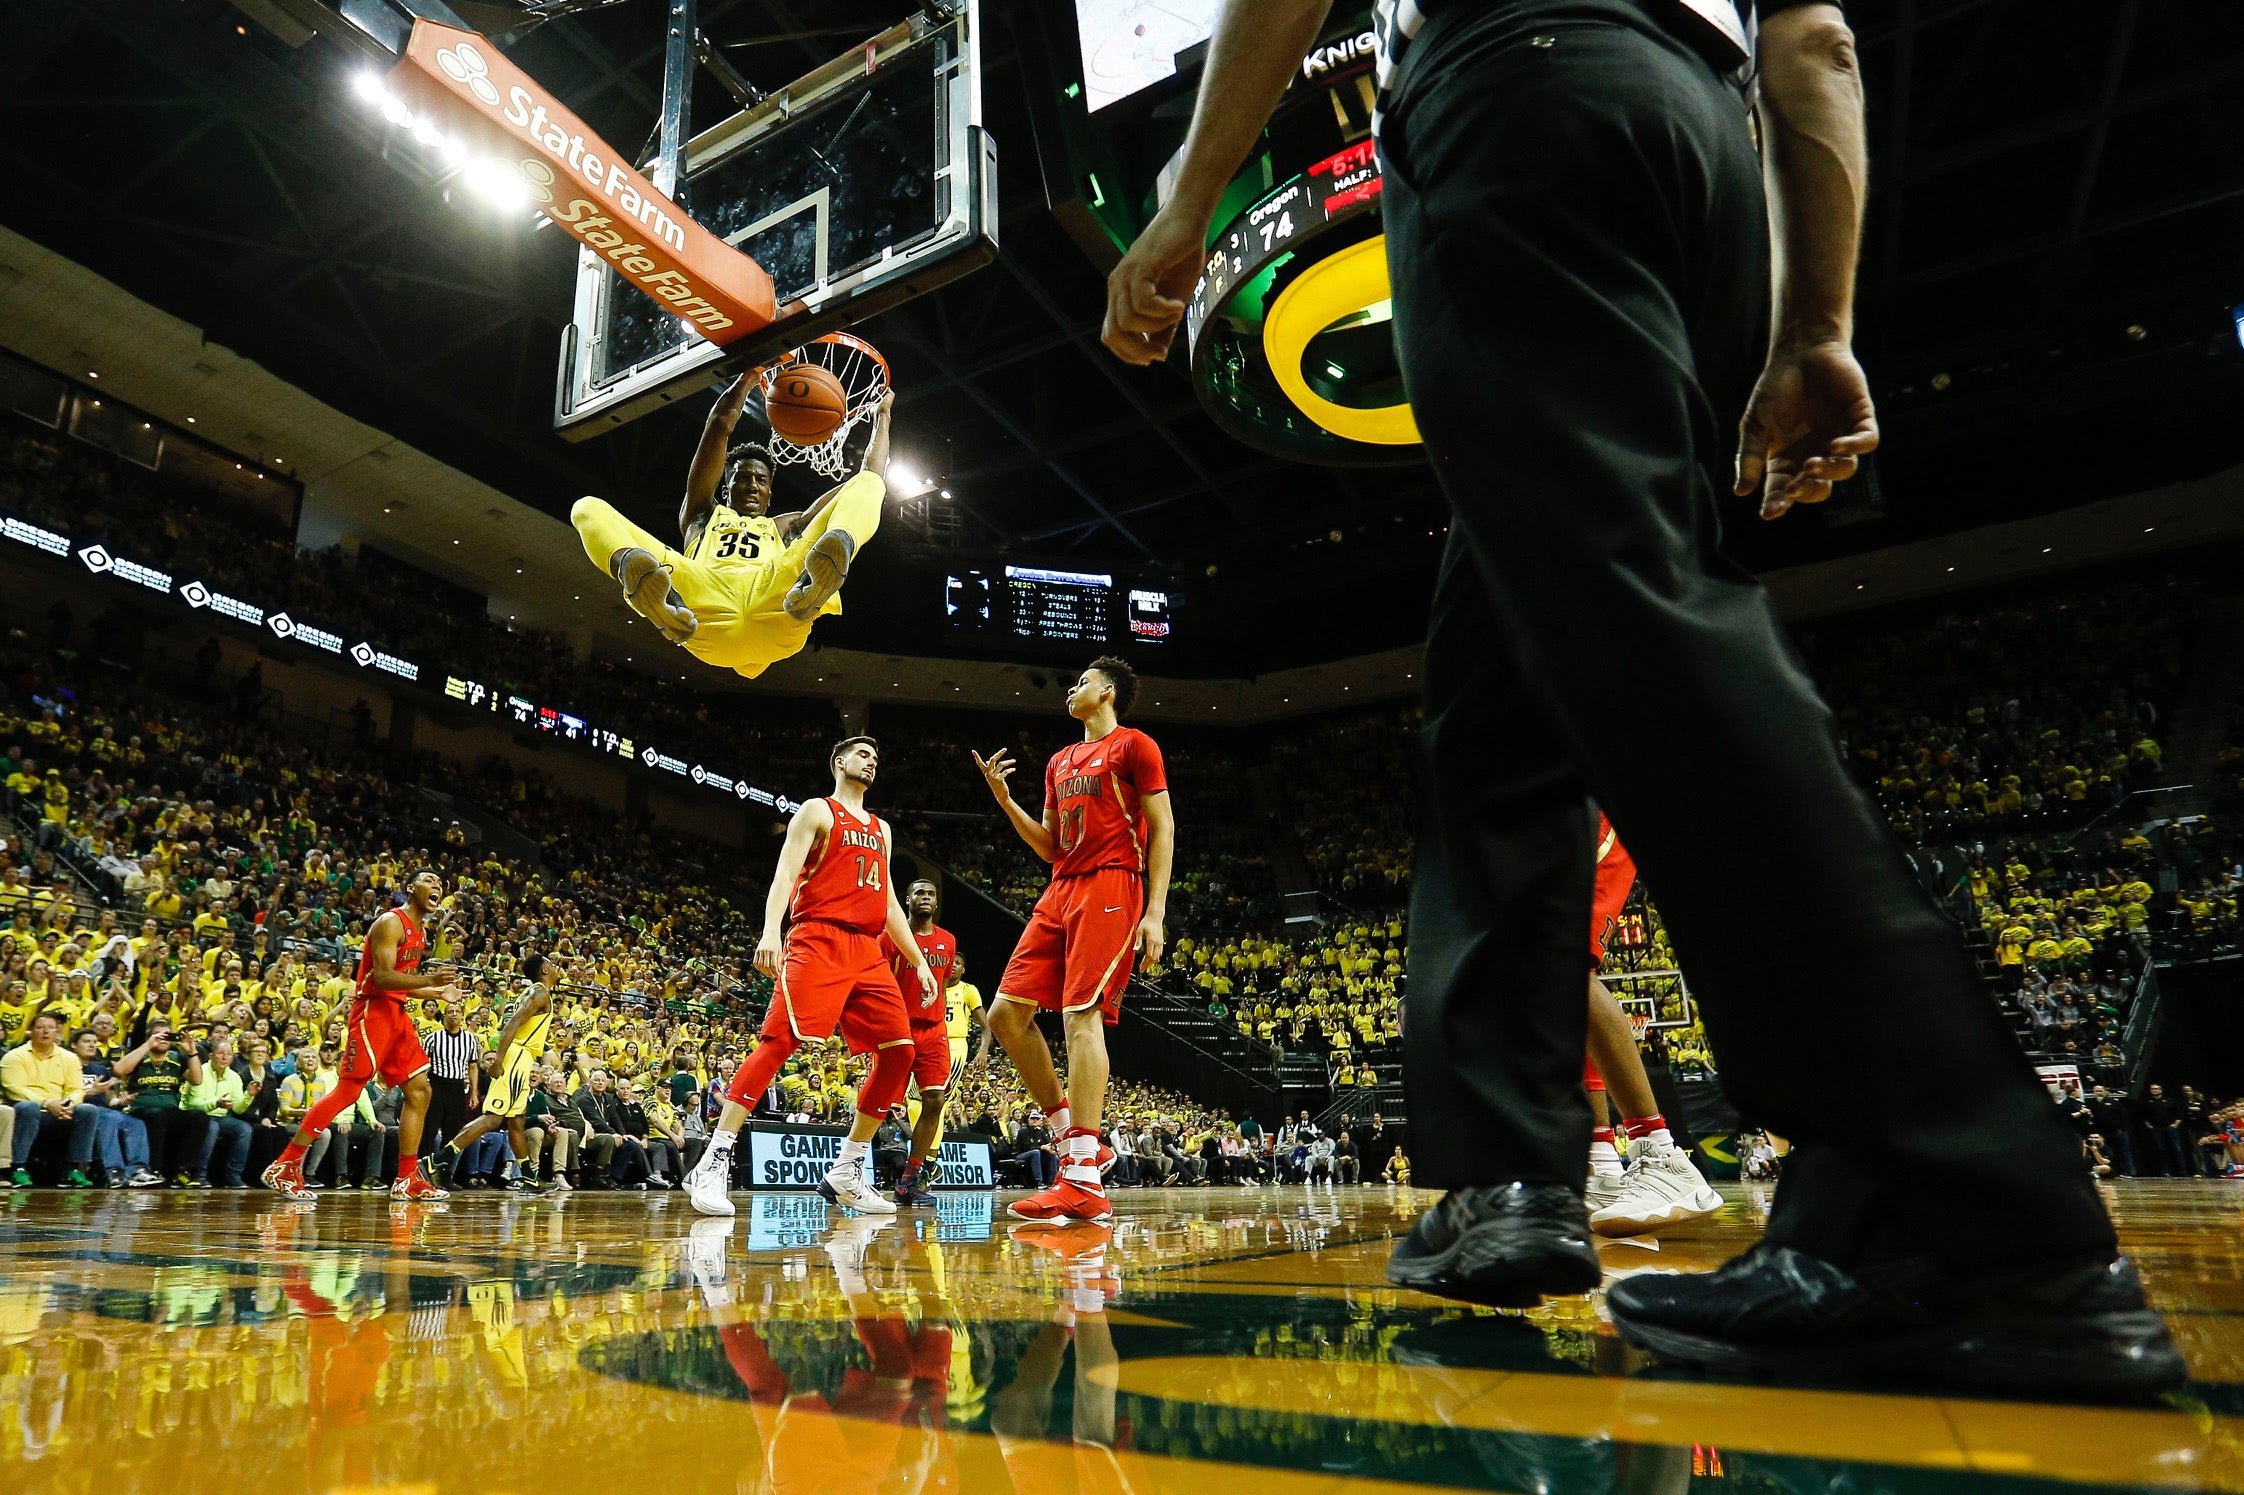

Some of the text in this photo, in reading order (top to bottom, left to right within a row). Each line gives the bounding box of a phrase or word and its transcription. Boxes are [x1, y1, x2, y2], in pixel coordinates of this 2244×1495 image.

[1249, 186, 1299, 226] Oregon
[1259, 211, 1295, 252] 74
[1232, 256, 1243, 275] 2
[716, 532, 760, 559] 35
[376, 652, 418, 672] OREGON
[509, 696, 534, 712] Oregon
[514, 708, 526, 722] 74
[659, 754, 687, 768] OREGON
[1060, 805, 1083, 850] 21
[855, 854, 883, 892] 14
[137, 1075, 179, 1084] OREGON
[780, 1134, 842, 1159] GAME
